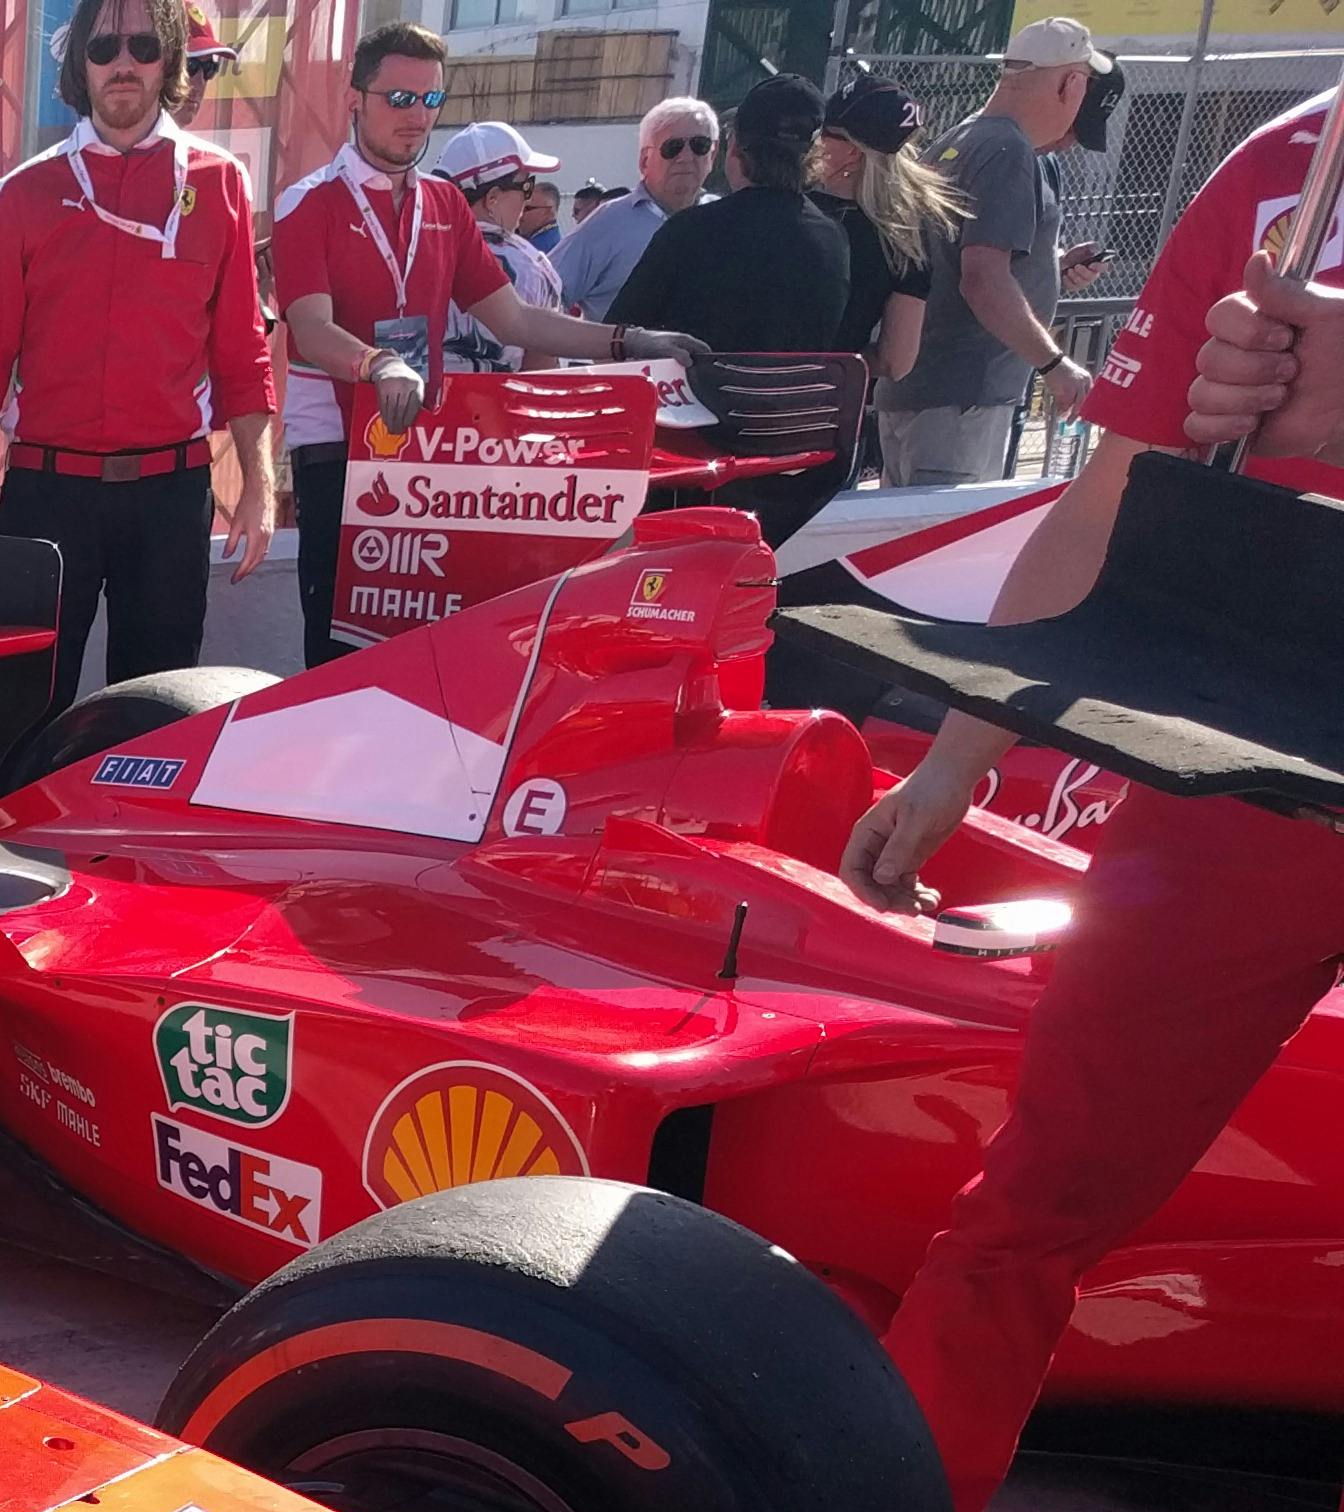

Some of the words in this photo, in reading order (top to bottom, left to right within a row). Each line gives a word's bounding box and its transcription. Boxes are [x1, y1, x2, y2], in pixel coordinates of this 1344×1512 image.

[415, 426, 586, 466] V-Power
[404, 473, 624, 524] Santander
[349, 586, 462, 622] MAHLE
[626, 606, 696, 622] SCHUMACHER
[97, 759, 182, 787] FIAT
[514, 789, 556, 835] E
[181, 1009, 267, 1076] tic
[47, 1061, 96, 1108] brembo
[169, 1047, 268, 1117] tac
[20, 1073, 53, 1110] SKF
[56, 1100, 102, 1148] MAHLE
[154, 1117, 312, 1241] FedEx
